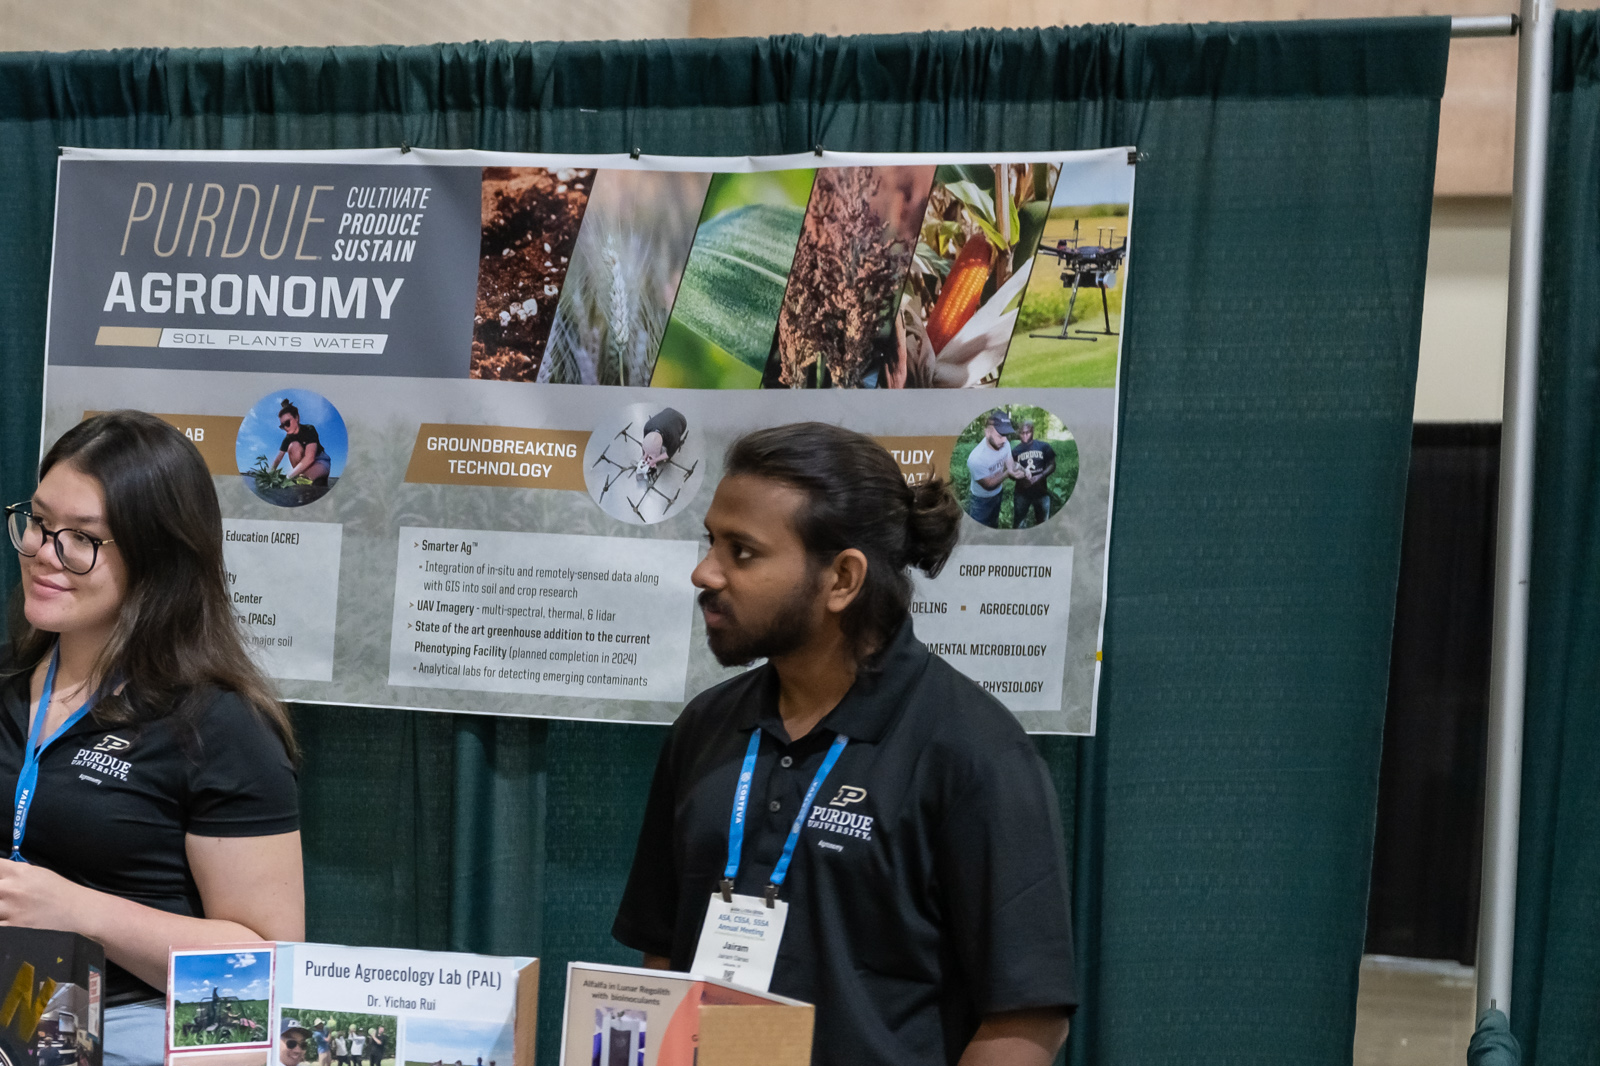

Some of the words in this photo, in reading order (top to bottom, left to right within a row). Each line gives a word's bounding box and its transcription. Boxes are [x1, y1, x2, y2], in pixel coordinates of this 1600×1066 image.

[346, 187, 432, 209] CULTIVATE
[120, 182, 334, 260] PURDUE
[338, 213, 424, 236] PRODUCE
[331, 239, 416, 262] SUSTAIN
[103, 271, 405, 319] AGRONOMY
[172, 333, 216, 345] SOIL
[228, 334, 302, 347] PLANTS
[313, 337, 375, 349] WATER
[184, 427, 204, 441] AB
[426, 437, 577, 458] GROUNDBREAKING
[890, 449, 934, 464] TUDY
[448, 459, 552, 478] TECHNOLOGY
[225, 530, 269, 543] Education
[270, 531, 300, 545] (ACRE)
[422, 540, 459, 552] Smarter
[424, 560, 474, 575] Integration
[476, 563, 486, 574] of
[487, 564, 515, 576] in-situ
[517, 566, 534, 578] and
[535, 568, 610, 582] remotely-sensed
[611, 570, 632, 582] data
[634, 572, 660, 586] along
[959, 564, 986, 577] CROP
[988, 565, 1051, 578] PRODUCTION
[233, 592, 263, 605] Center
[423, 580, 443, 591] with
[445, 580, 460, 592] GIS
[462, 582, 479, 593] into
[481, 583, 497, 594] soil
[499, 584, 515, 596] and
[517, 587, 537, 598] crop
[539, 587, 578, 599] research
[417, 600, 435, 611] UAV
[436, 601, 474, 616] Imagery
[482, 604, 546, 618] multi-spectral,
[548, 607, 585, 621] thermal,
[587, 608, 593, 621] &
[595, 609, 616, 621] lidar
[909, 602, 947, 614] DELING
[980, 602, 1050, 616] AGROECOLOGY
[248, 614, 276, 626] (PACs)
[415, 620, 440, 633] State
[442, 622, 452, 633] of
[454, 623, 469, 634] the
[471, 625, 485, 635] art
[487, 626, 541, 638] greenhouse
[543, 628, 583, 640] addition
[585, 630, 595, 641] to
[597, 631, 613, 642] the
[615, 633, 651, 644] current
[414, 641, 471, 657] Phenotyping
[473, 645, 507, 660] Facility
[509, 646, 547, 660] (planned
[549, 650, 599, 663] completion
[601, 651, 610, 663] in
[611, 652, 637, 665] 2024)
[970, 643, 1047, 657] MICROBIOLOGY
[418, 662, 461, 676] Analytical
[462, 664, 481, 677] labs
[483, 666, 496, 678] for
[498, 668, 541, 682] detecting
[542, 671, 584, 685] emerging
[586, 673, 648, 687] contaminants
[982, 681, 1044, 693] PHYSIOLOGY
[73, 748, 132, 774] PURDUE
[14, 788, 30, 827] CORTEVA
[735, 784, 748, 824] CORTEVA
[809, 806, 873, 831] PURDUE
[305, 960, 350, 978] Purdue
[354, 963, 434, 986] Agroecology
[438, 968, 462, 985] Lab
[466, 970, 501, 991] (PAL)
[583, 979, 607, 989] Alfalfa
[617, 983, 638, 992] Lunar
[639, 986, 670, 996] Regolith
[591, 992, 608, 1000] with
[367, 994, 381, 1008] Dr.
[384, 996, 417, 1009] Yichao
[419, 998, 436, 1010] Rui
